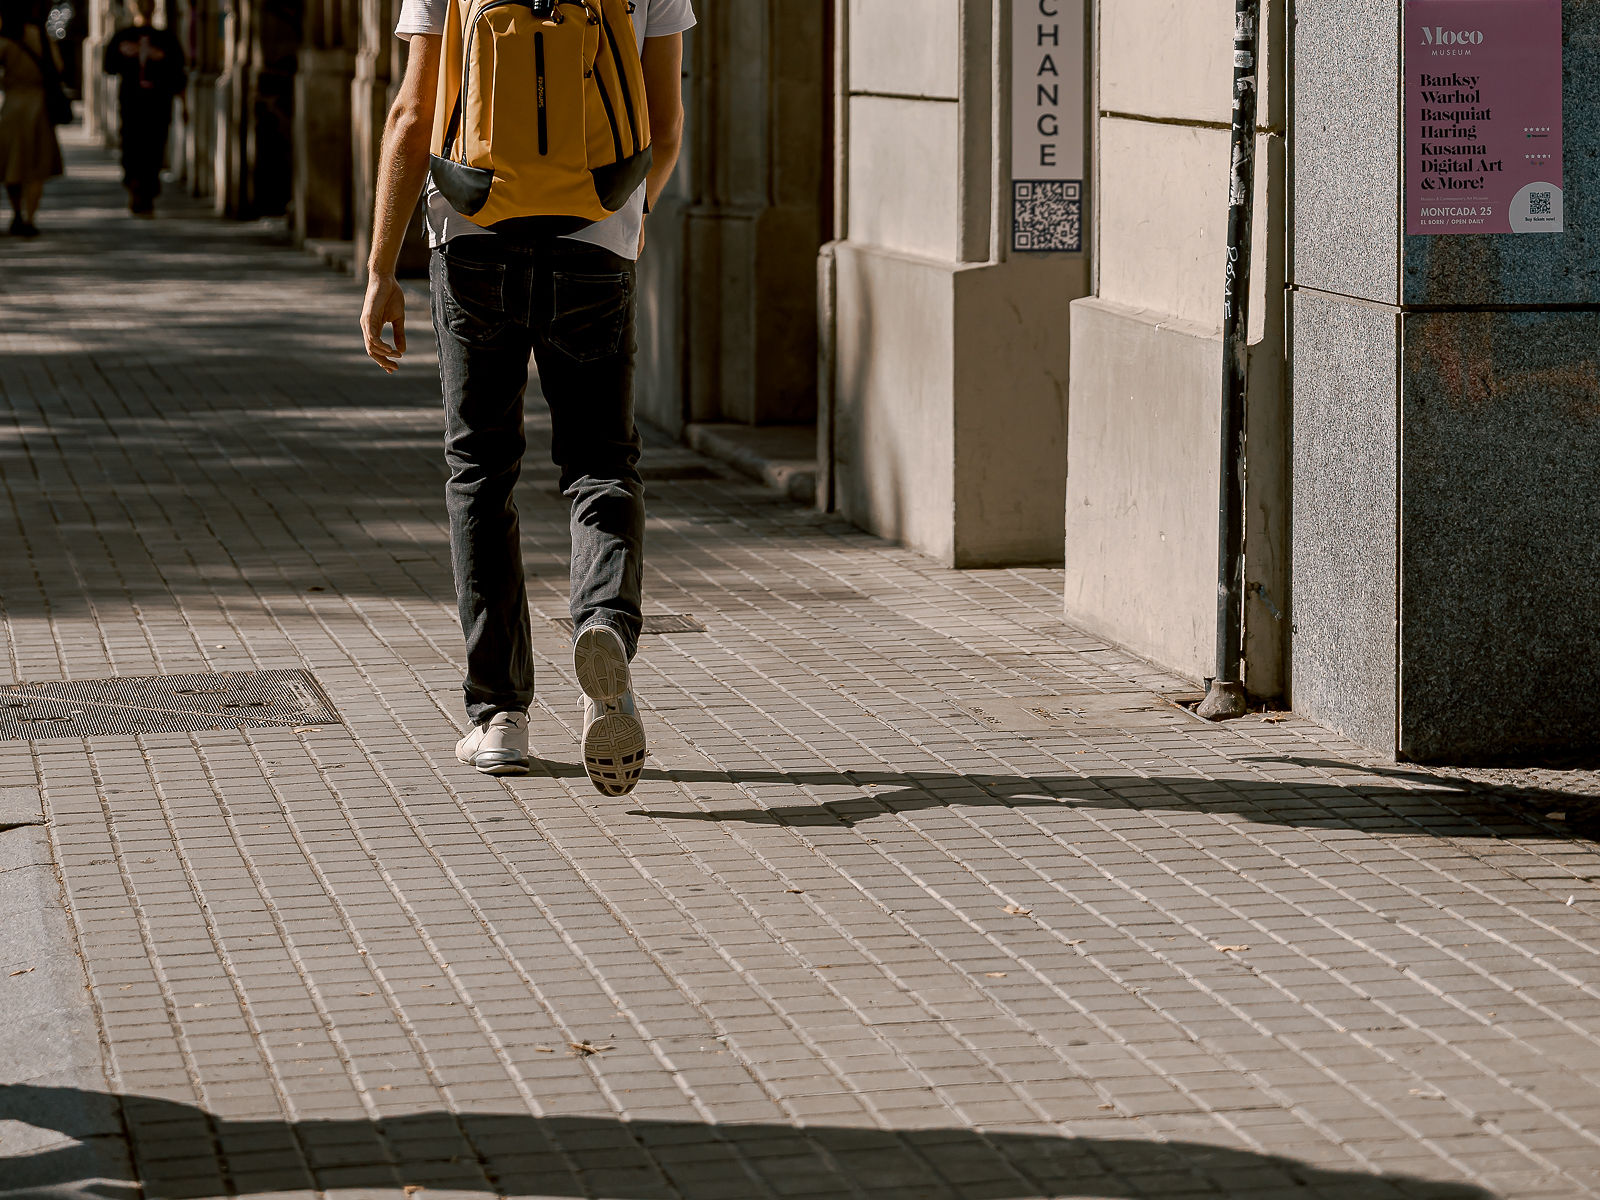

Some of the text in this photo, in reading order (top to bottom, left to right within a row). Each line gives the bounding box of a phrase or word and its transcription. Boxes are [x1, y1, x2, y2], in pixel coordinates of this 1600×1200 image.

[1420, 26, 1484, 46] Moco
[1420, 72, 1480, 89] Banksy
[1420, 89, 1480, 104] Warhol
[1420, 106, 1491, 124] Basquiat
[1420, 124, 1477, 140] Haring
[1420, 143, 1487, 155] Kusama
[1420, 158, 1503, 175] Digital Art
[1420, 207, 1492, 217] MONTCADA 25
